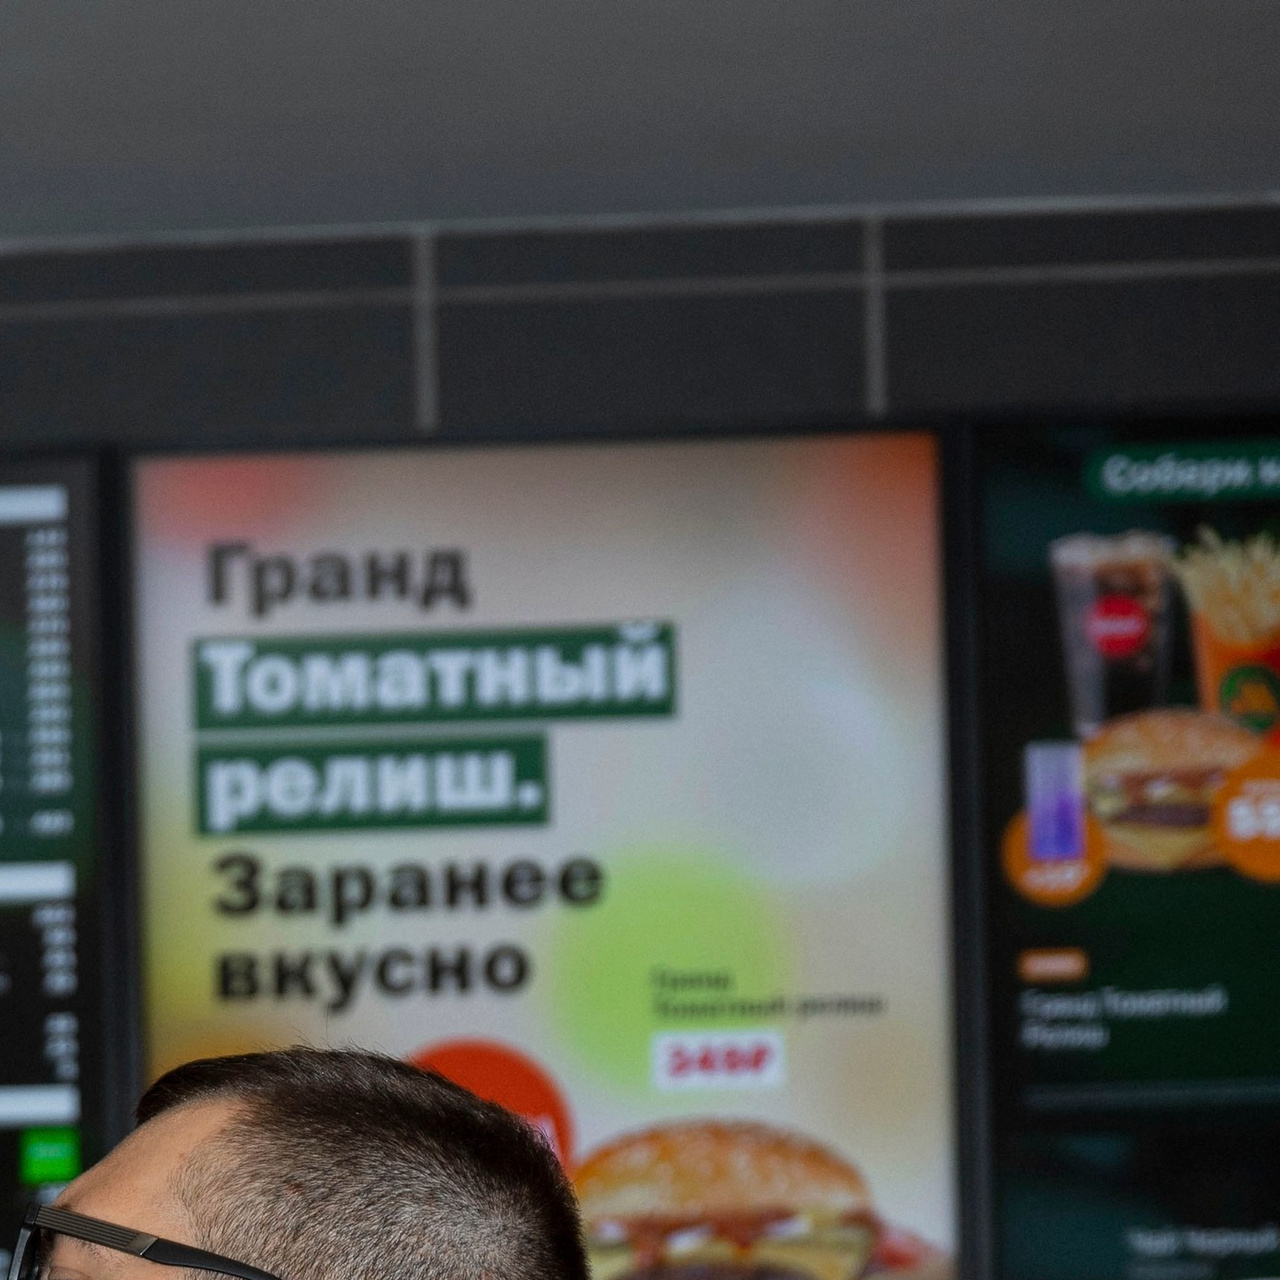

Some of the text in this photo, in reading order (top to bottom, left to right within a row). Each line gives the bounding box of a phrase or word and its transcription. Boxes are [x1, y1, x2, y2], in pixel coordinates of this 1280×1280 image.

[207, 540, 473, 617] Гранд
[202, 623, 668, 714] Томатный
[207, 750, 542, 832] релиш.
[213, 851, 605, 927] Заранее
[216, 944, 531, 1014] вкусно
